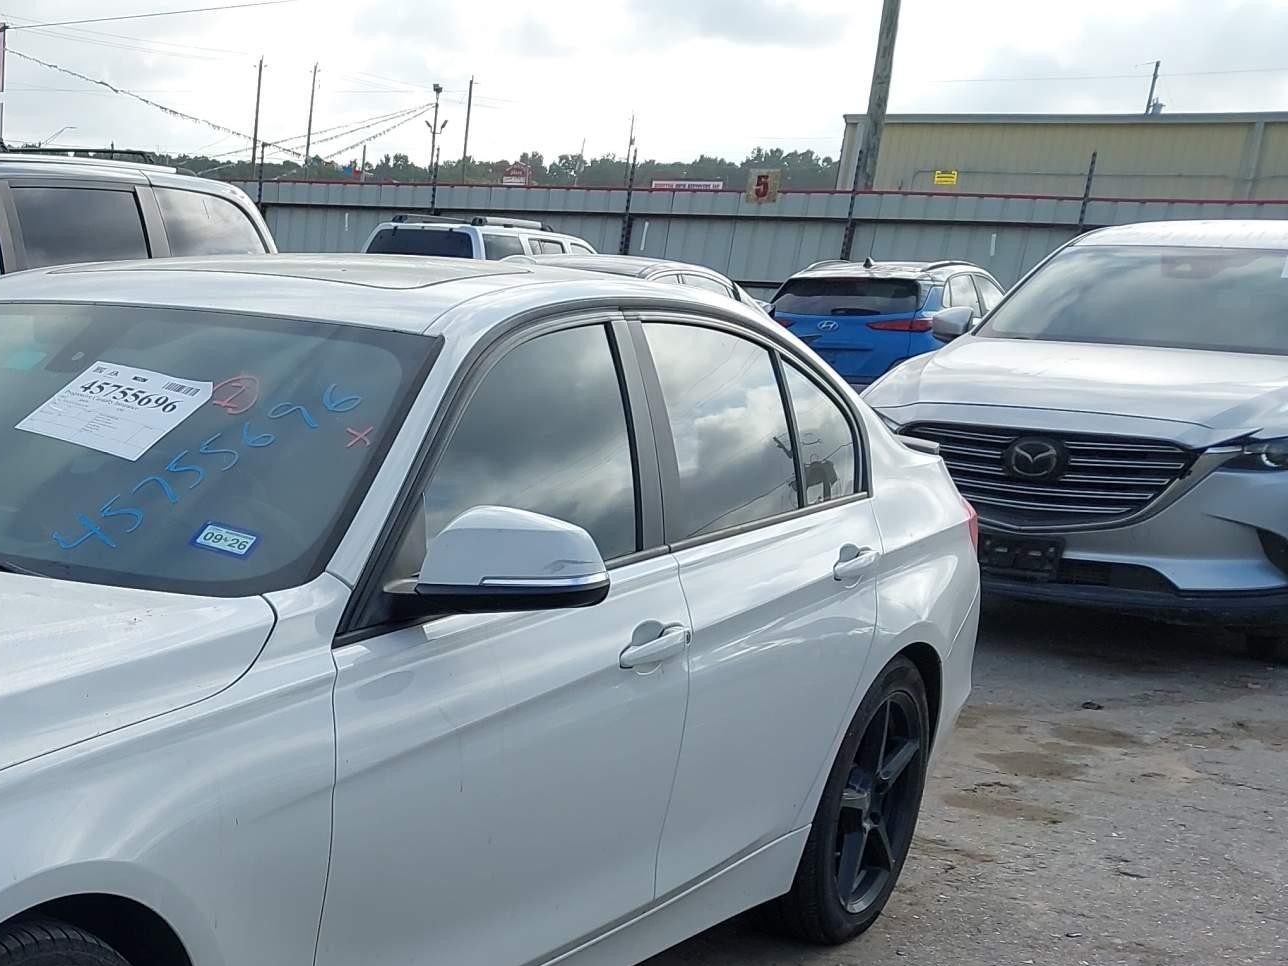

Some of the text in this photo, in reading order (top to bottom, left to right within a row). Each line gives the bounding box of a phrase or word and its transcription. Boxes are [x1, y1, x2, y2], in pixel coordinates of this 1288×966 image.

[755, 174, 769, 198] 5
[79, 379, 184, 413] 45755696
[52, 383, 362, 550] 45755696
[203, 531, 224, 544] 09
[227, 538, 249, 551] 26
